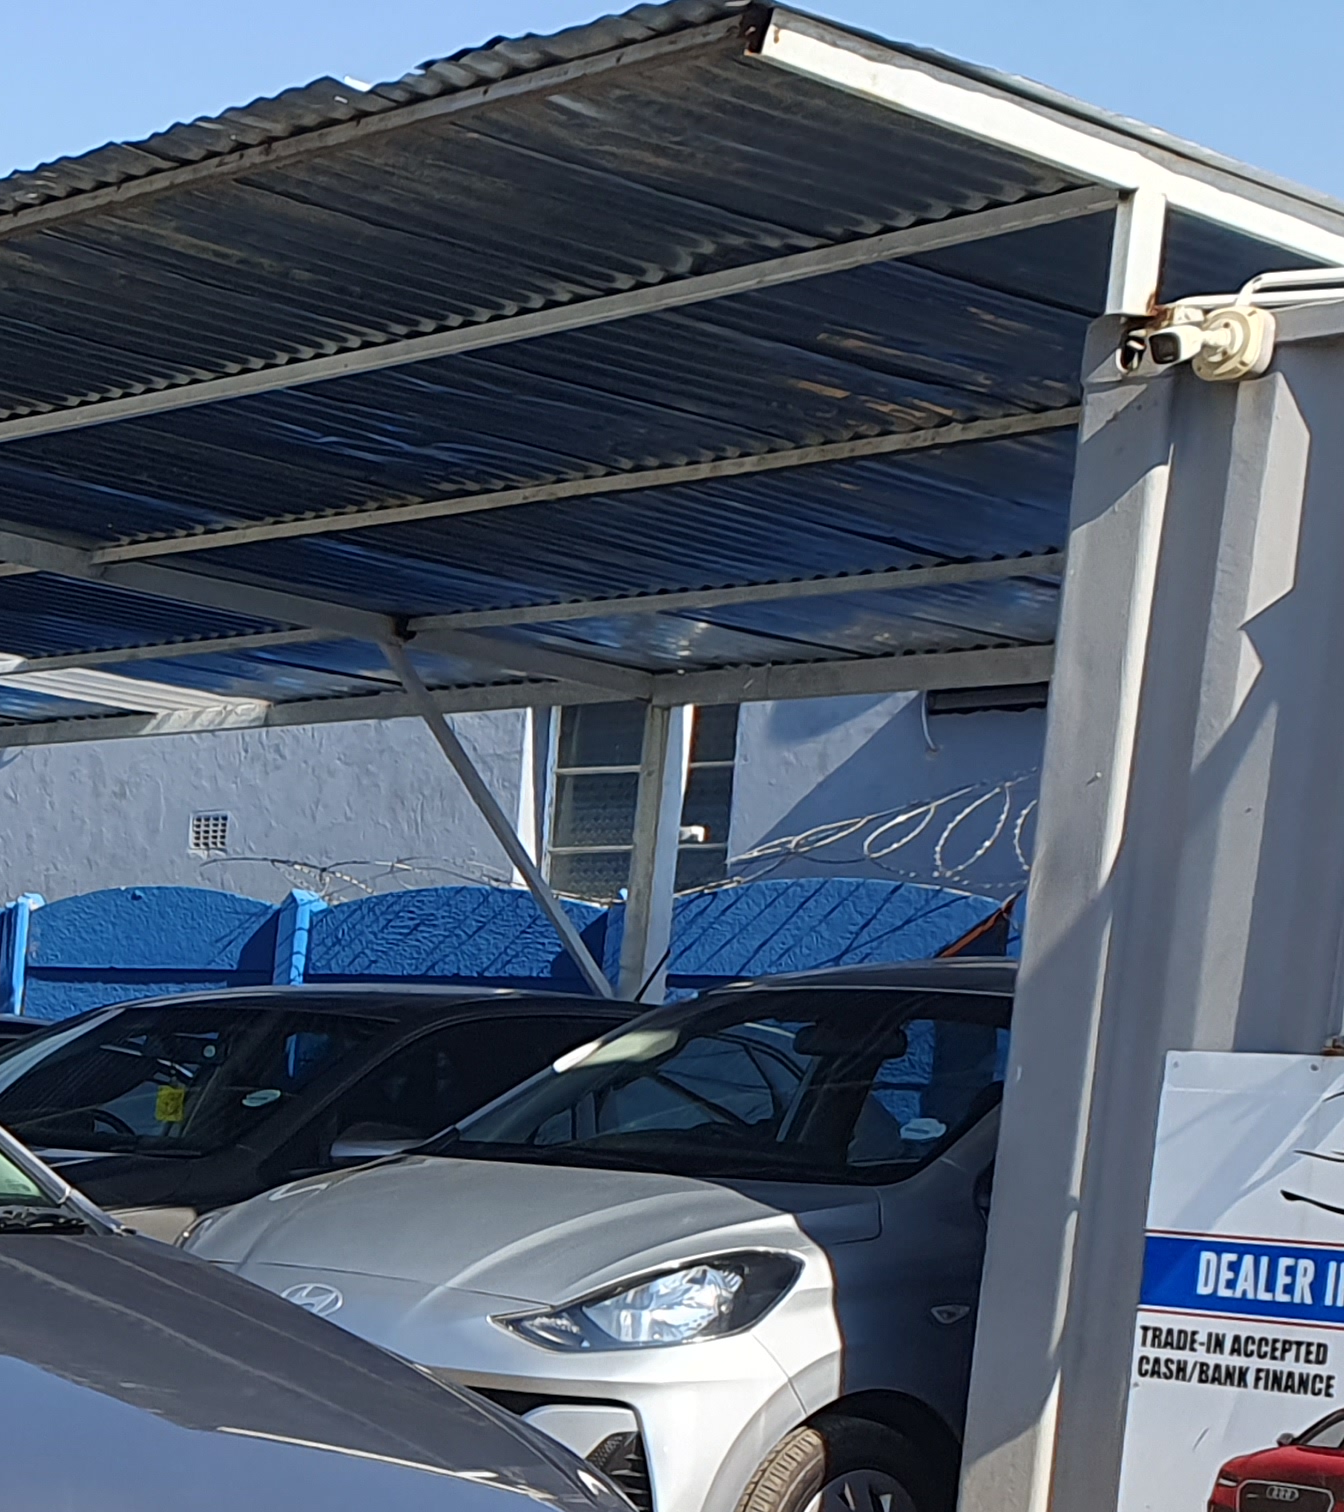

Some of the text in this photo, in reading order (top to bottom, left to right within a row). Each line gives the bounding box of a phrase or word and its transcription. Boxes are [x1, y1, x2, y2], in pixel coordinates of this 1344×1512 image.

[1196, 1251, 1316, 1305] DEALER
[1139, 1325, 1329, 1366] TRADE-IN ACCEPTED
[1137, 1355, 1336, 1398] CASH/BANK FINANCE
